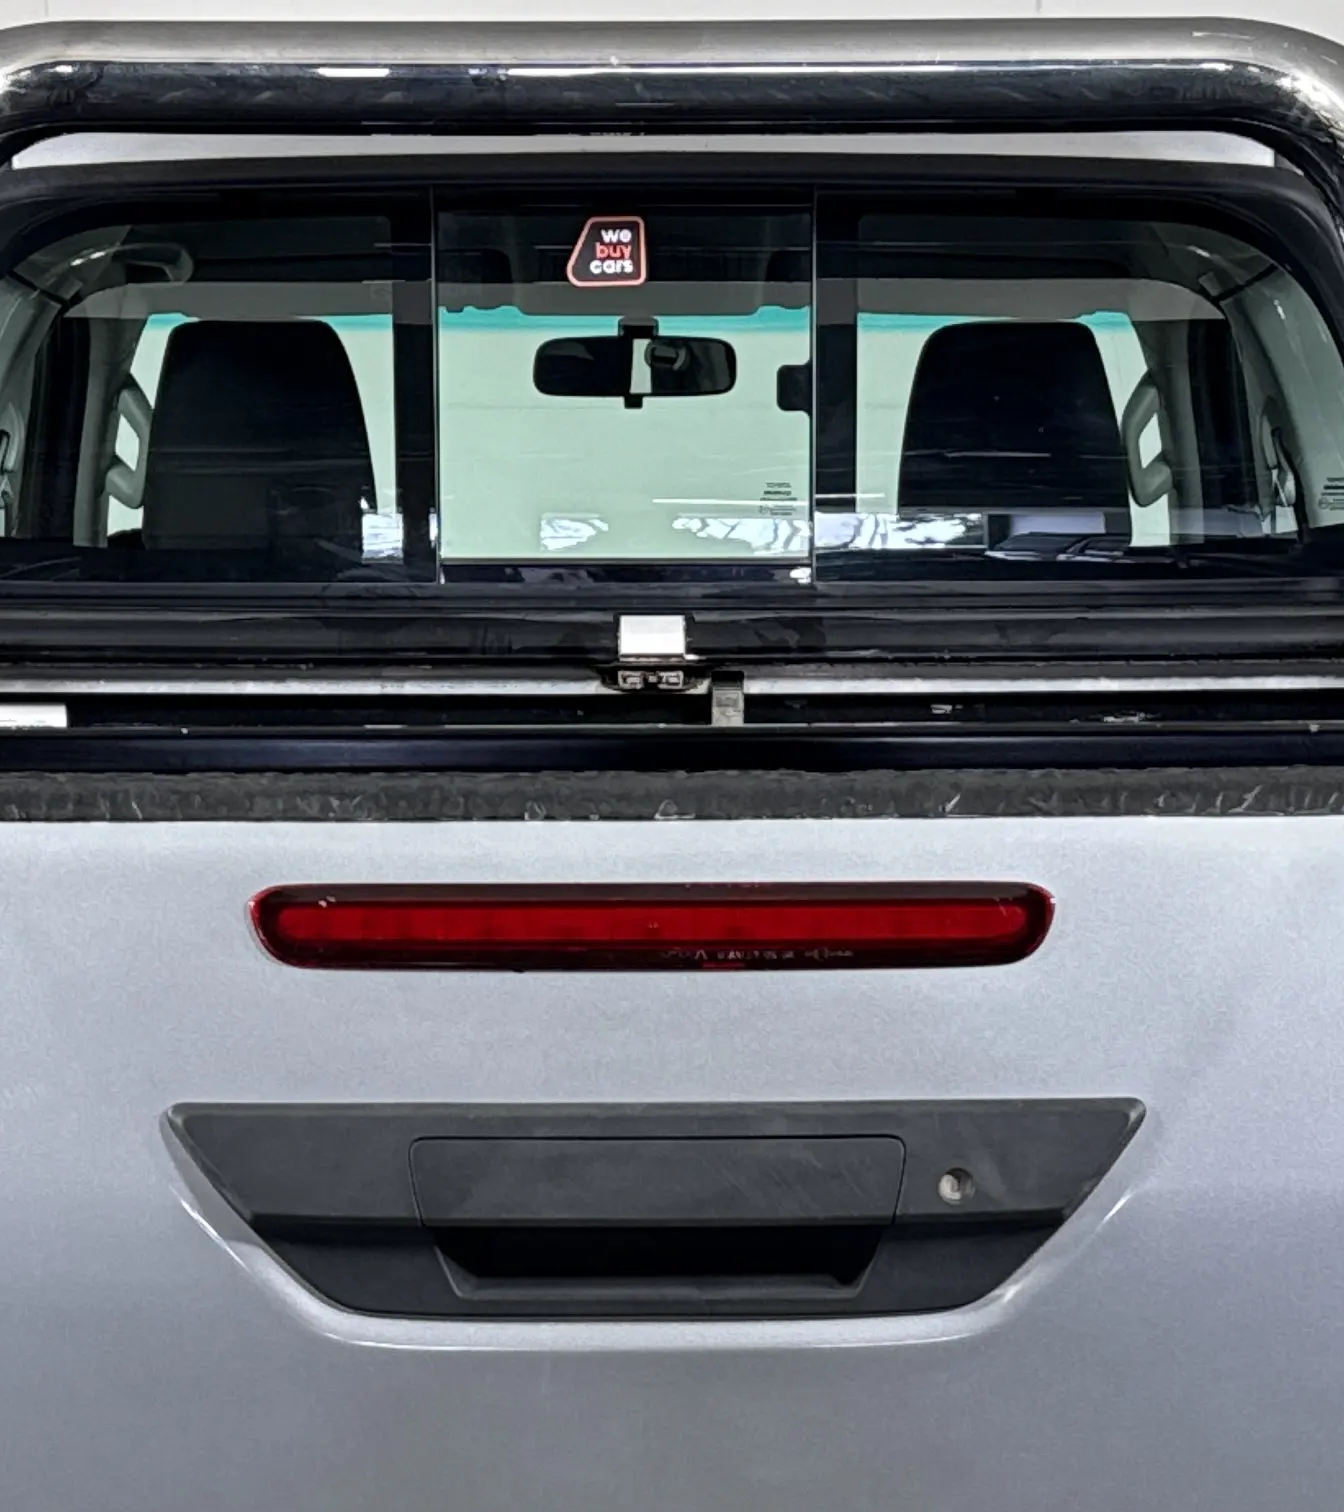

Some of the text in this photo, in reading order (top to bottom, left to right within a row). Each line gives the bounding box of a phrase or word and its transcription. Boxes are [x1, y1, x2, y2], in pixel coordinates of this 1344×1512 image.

[601, 229, 632, 243] we
[596, 242, 632, 260] buy
[590, 260, 633, 274] cars
